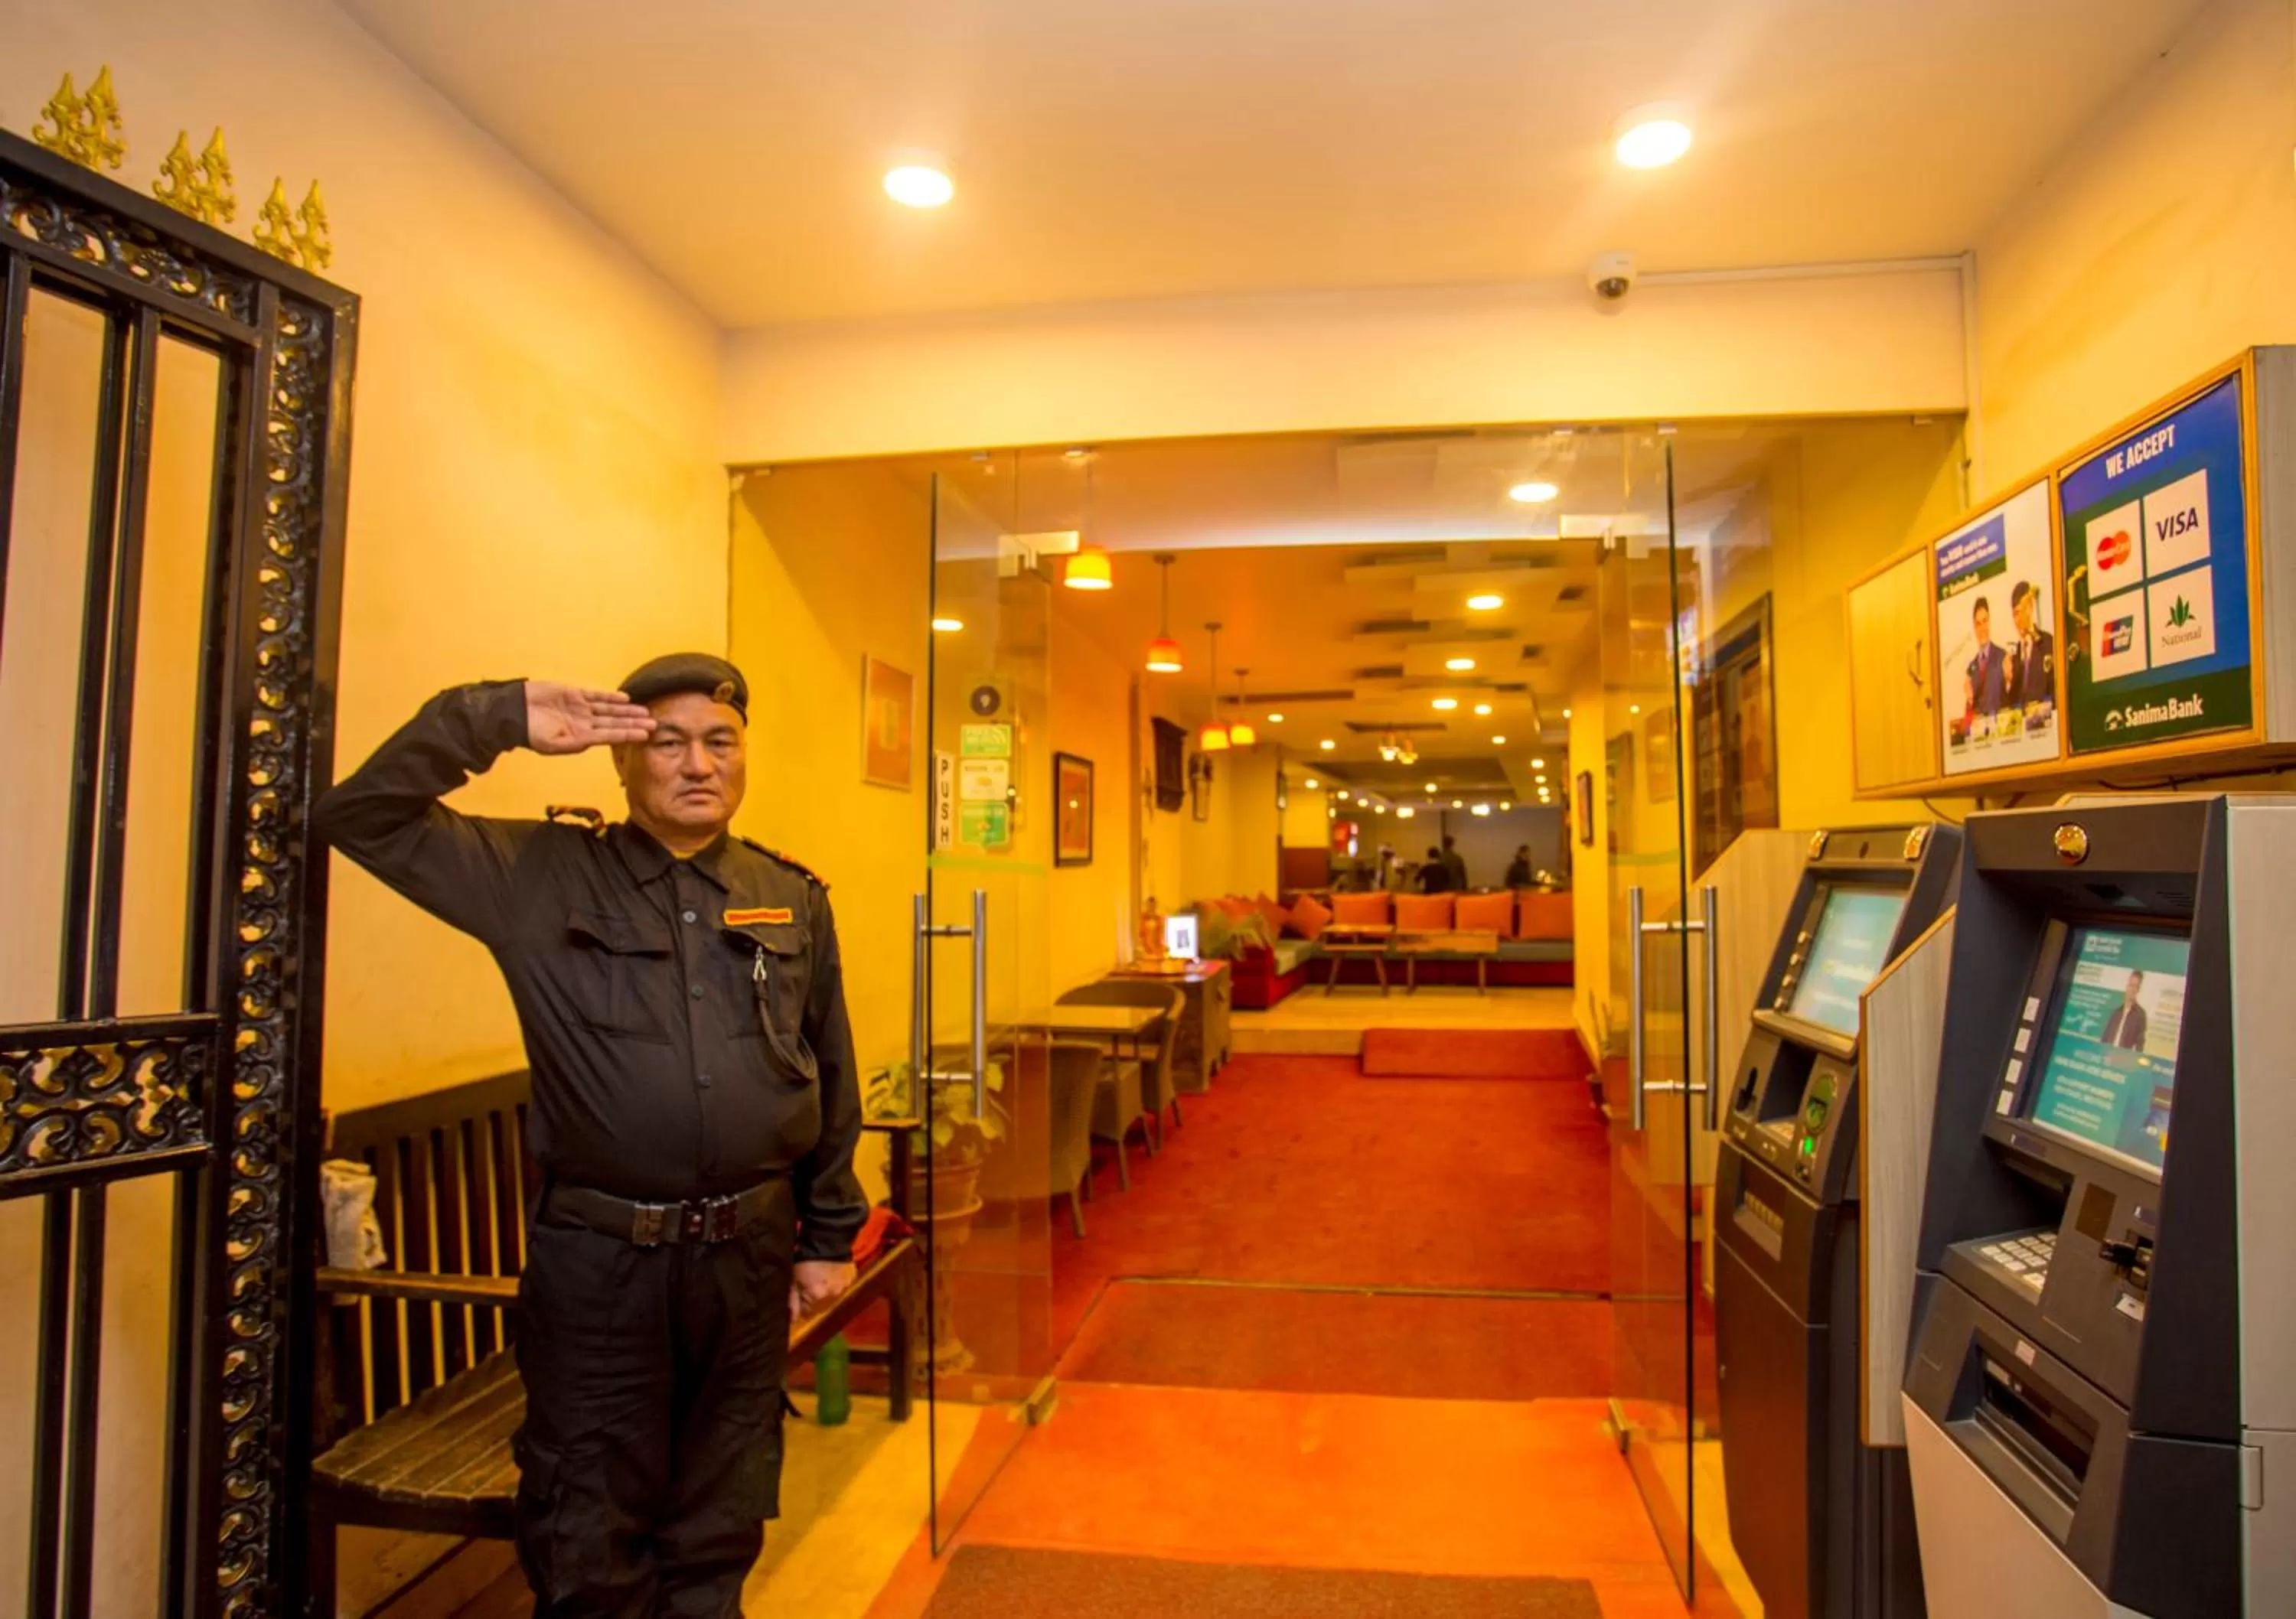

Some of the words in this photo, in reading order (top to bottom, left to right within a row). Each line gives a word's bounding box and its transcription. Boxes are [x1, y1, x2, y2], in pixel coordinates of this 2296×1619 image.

[2105, 451, 2125, 480] WE
[2126, 423, 2176, 470] ACCEPT
[2155, 507, 2199, 542] VISA
[2161, 626, 2202, 648] National
[2125, 692, 2204, 728] SanimaBank
[940, 758, 950, 845] PUSH
